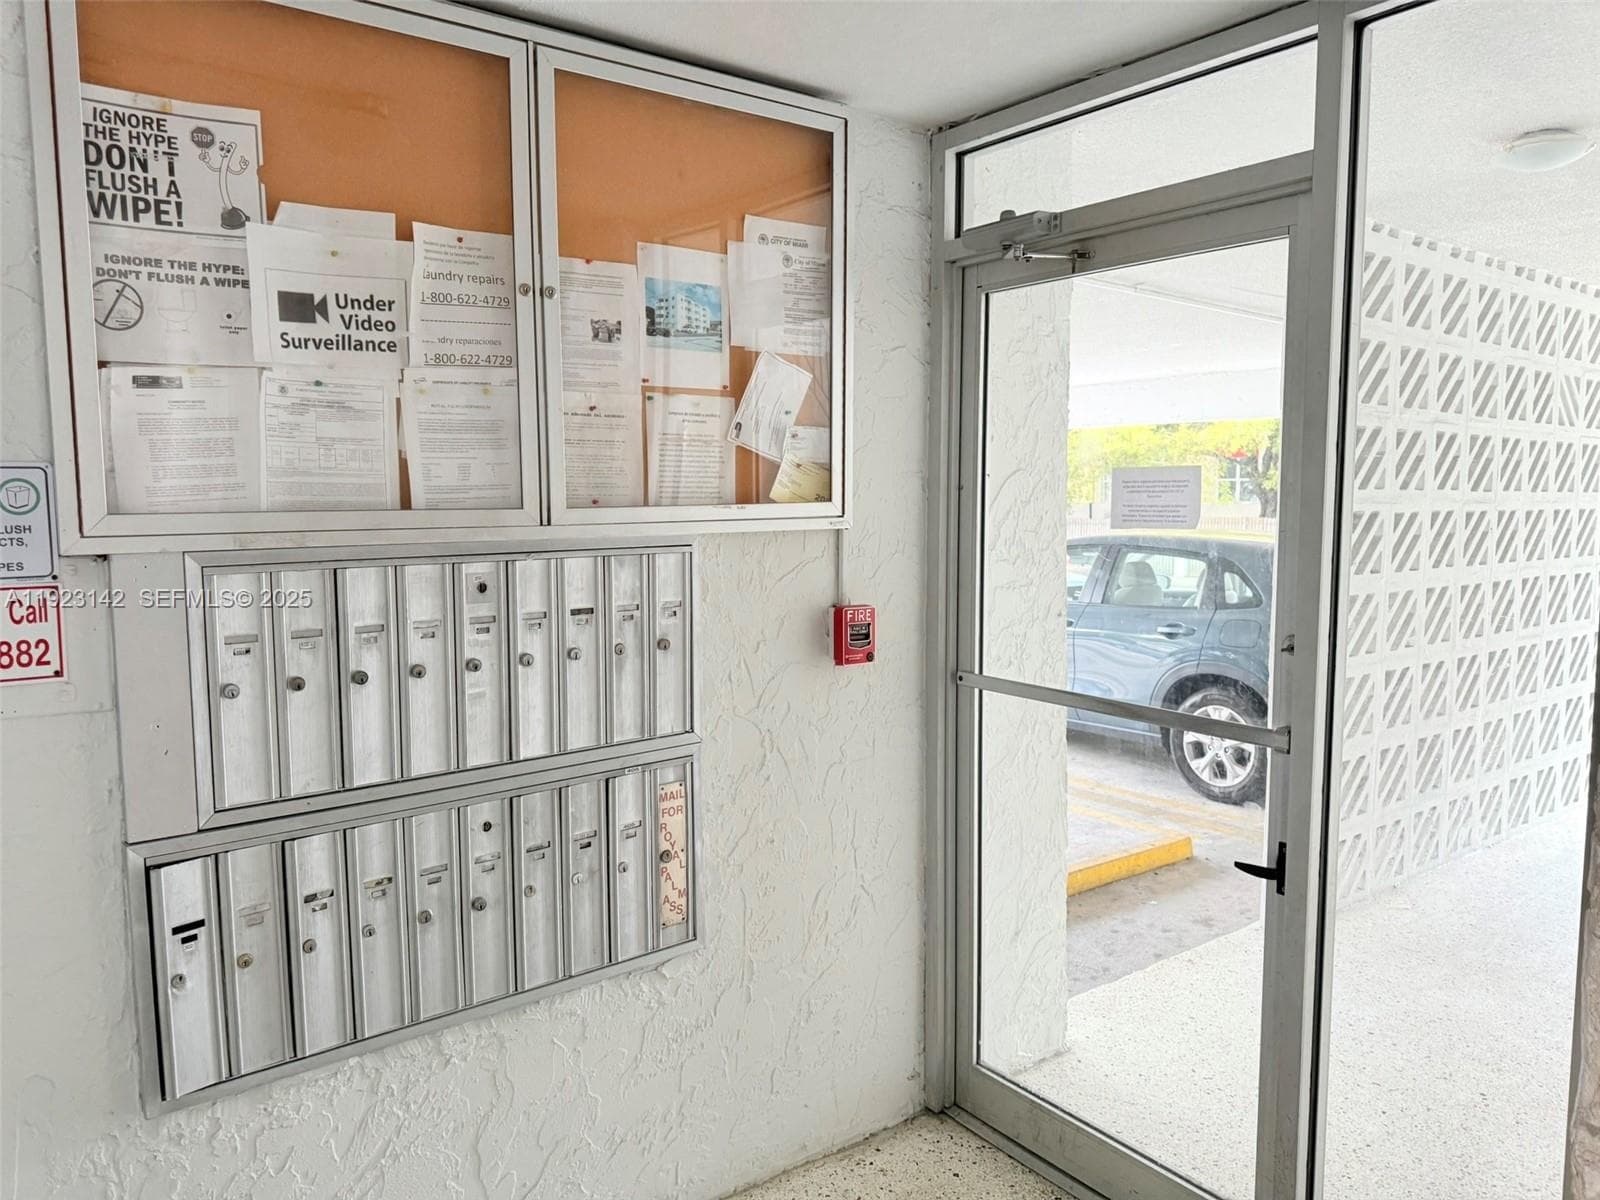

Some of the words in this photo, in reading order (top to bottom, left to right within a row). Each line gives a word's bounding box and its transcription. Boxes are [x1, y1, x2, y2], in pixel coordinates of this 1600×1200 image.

[92, 107, 168, 133] IGNORE
[83, 123, 121, 142] THE
[128, 131, 179, 150] HYPE
[193, 132, 213, 143] STOP
[83, 140, 179, 177] DON'T
[85, 169, 158, 196] FLUSH
[166, 179, 181, 199] A
[86, 190, 184, 227] WIPE!
[104, 253, 163, 269] IGNORE
[167, 259, 197, 271] THE
[202, 262, 245, 276] HYPE:
[95, 267, 142, 280] DON'T
[147, 271, 195, 285] FLUSH
[200, 276, 210, 286] A
[213, 277, 250, 289] WIPE
[467, 274, 505, 286] repairs
[335, 293, 395, 311] Under
[421, 291, 510, 307] 1-800-622-4729
[339, 314, 396, 332] Video
[280, 332, 397, 352] Surveillance
[424, 353, 513, 366] 1-800-622-4729
[9, 597, 48, 625] Call
[847, 609, 871, 622] FIRE
[0, 639, 51, 669] 882
[659, 789, 685, 803] MAIL
[661, 805, 684, 818] FOR
[660, 822, 685, 869] ROYAL
[660, 866, 687, 899] PALM
